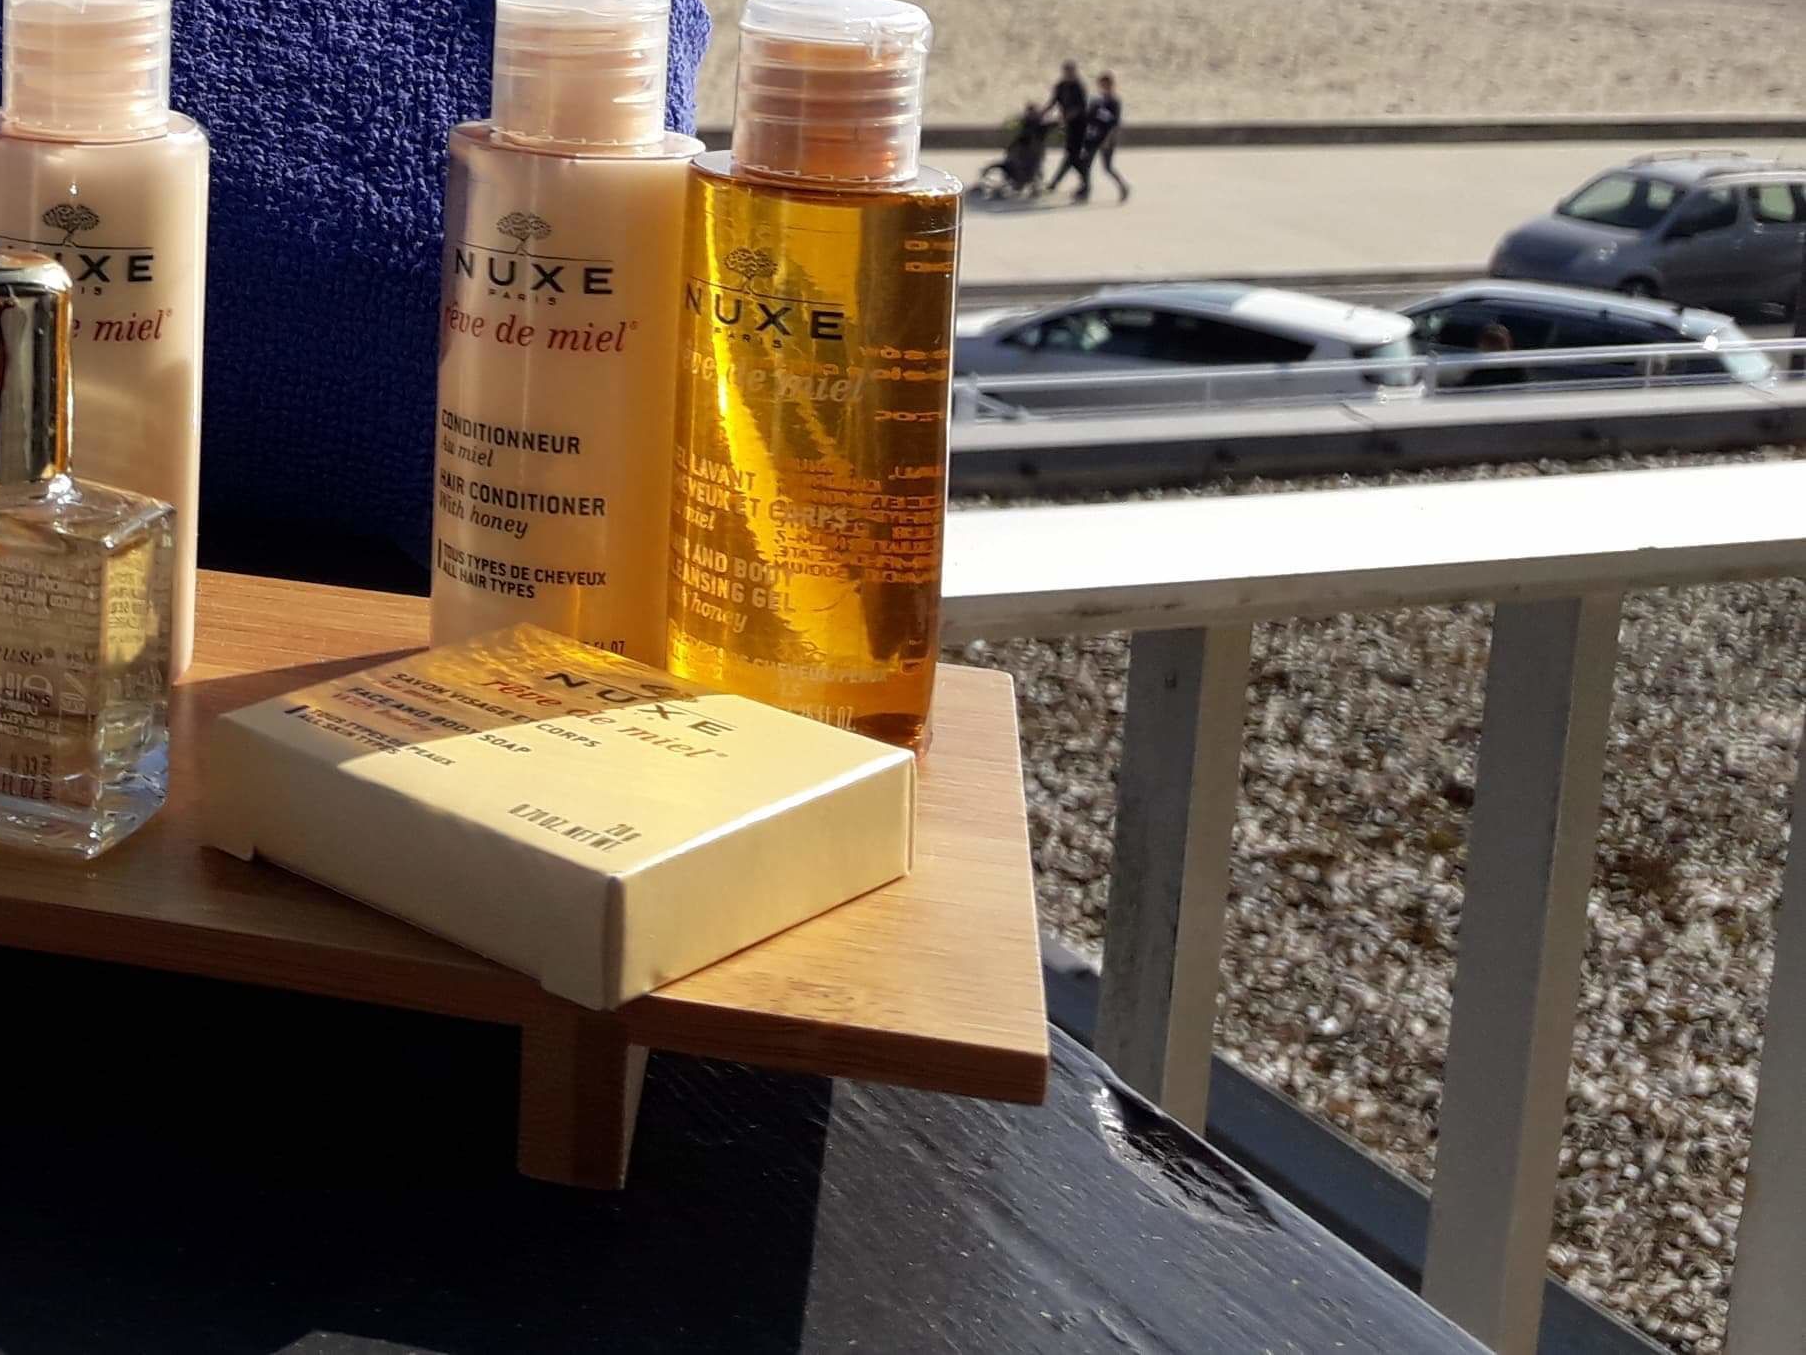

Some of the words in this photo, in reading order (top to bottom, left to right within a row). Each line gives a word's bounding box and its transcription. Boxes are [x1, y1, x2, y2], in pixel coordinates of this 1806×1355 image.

[455, 248, 614, 295] NUXE
[488, 289, 557, 306] PARIS
[685, 282, 844, 341] NUXE
[445, 301, 485, 338] rêve
[496, 314, 535, 347] de
[441, 408, 581, 455] CONDITIONNEUR
[457, 445, 494, 468] miel
[690, 453, 756, 492] LAVANT
[440, 467, 465, 495] HAIR
[469, 481, 606, 516] CONDITIONER
[470, 505, 529, 539] honey
[442, 561, 457, 579] ALL
[460, 569, 487, 589] HAIR
[490, 578, 535, 599] TYPES
[467, 553, 506, 577] TYPES
[510, 564, 530, 581] DE
[534, 568, 606, 586] CHEVEUX
[691, 543, 728, 573] AND
[676, 557, 746, 604] EANSING
[752, 582, 796, 613] GEL
[690, 591, 748, 633] honey
[347, 687, 394, 705] FACE
[393, 702, 431, 718] AND
[429, 716, 482, 734] BODY
[478, 733, 532, 754] SOAP
[392, 673, 450, 693] SAVON
[450, 691, 515, 718] VISAGE
[536, 722, 603, 748] CORPS
[481, 680, 562, 707] rêve
[567, 706, 617, 725] de
[544, 672, 735, 737] NUXE
